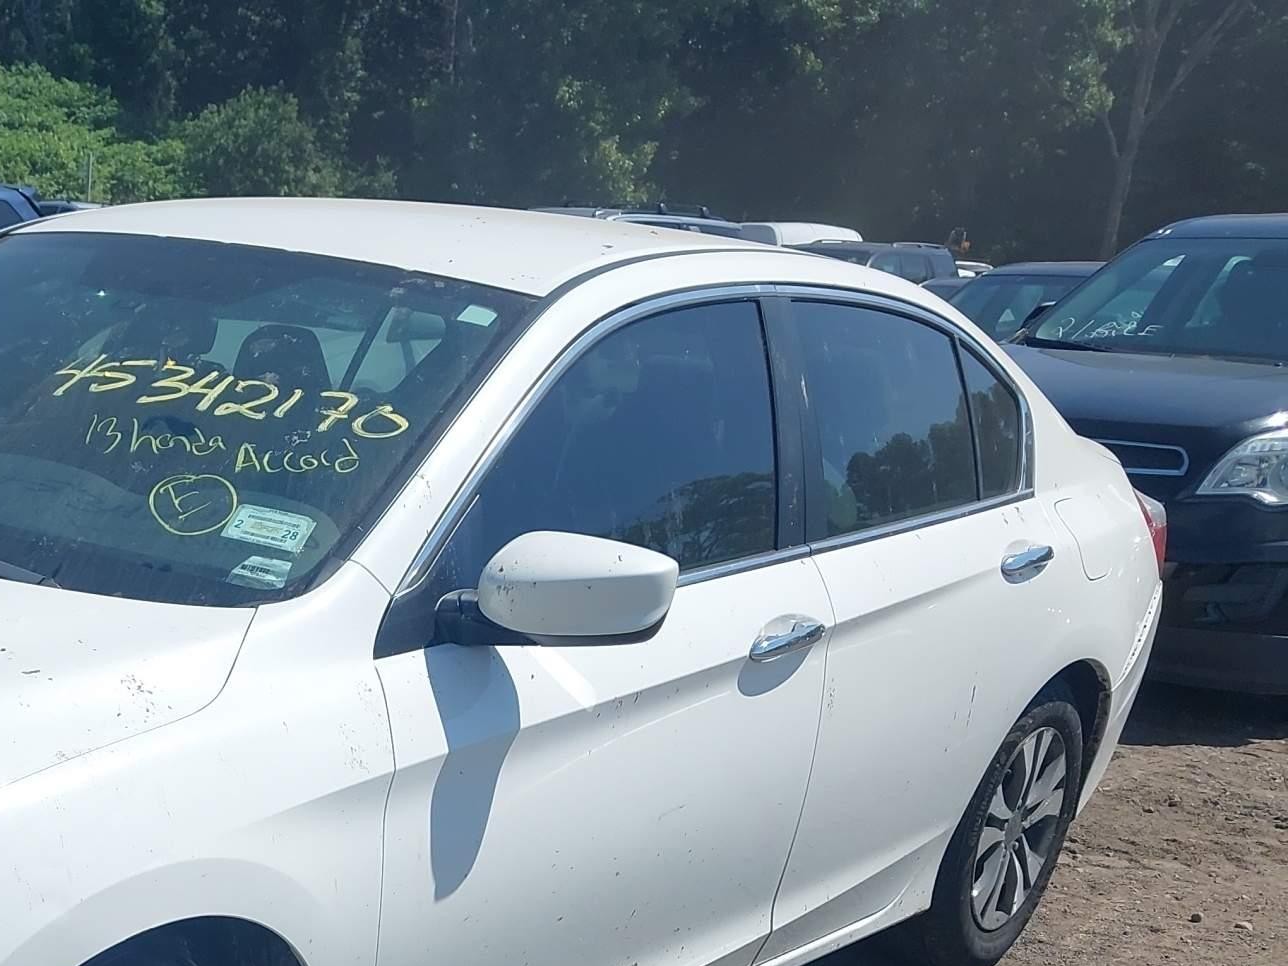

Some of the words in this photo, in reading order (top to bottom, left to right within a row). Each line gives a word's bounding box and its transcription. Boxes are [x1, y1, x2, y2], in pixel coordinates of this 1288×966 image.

[53, 353, 410, 439] 45342170
[85, 414, 122, 454] 13
[129, 417, 227, 456] honda
[234, 437, 361, 474] Accord
[233, 519, 245, 529] 2
[281, 529, 299, 541] 28
